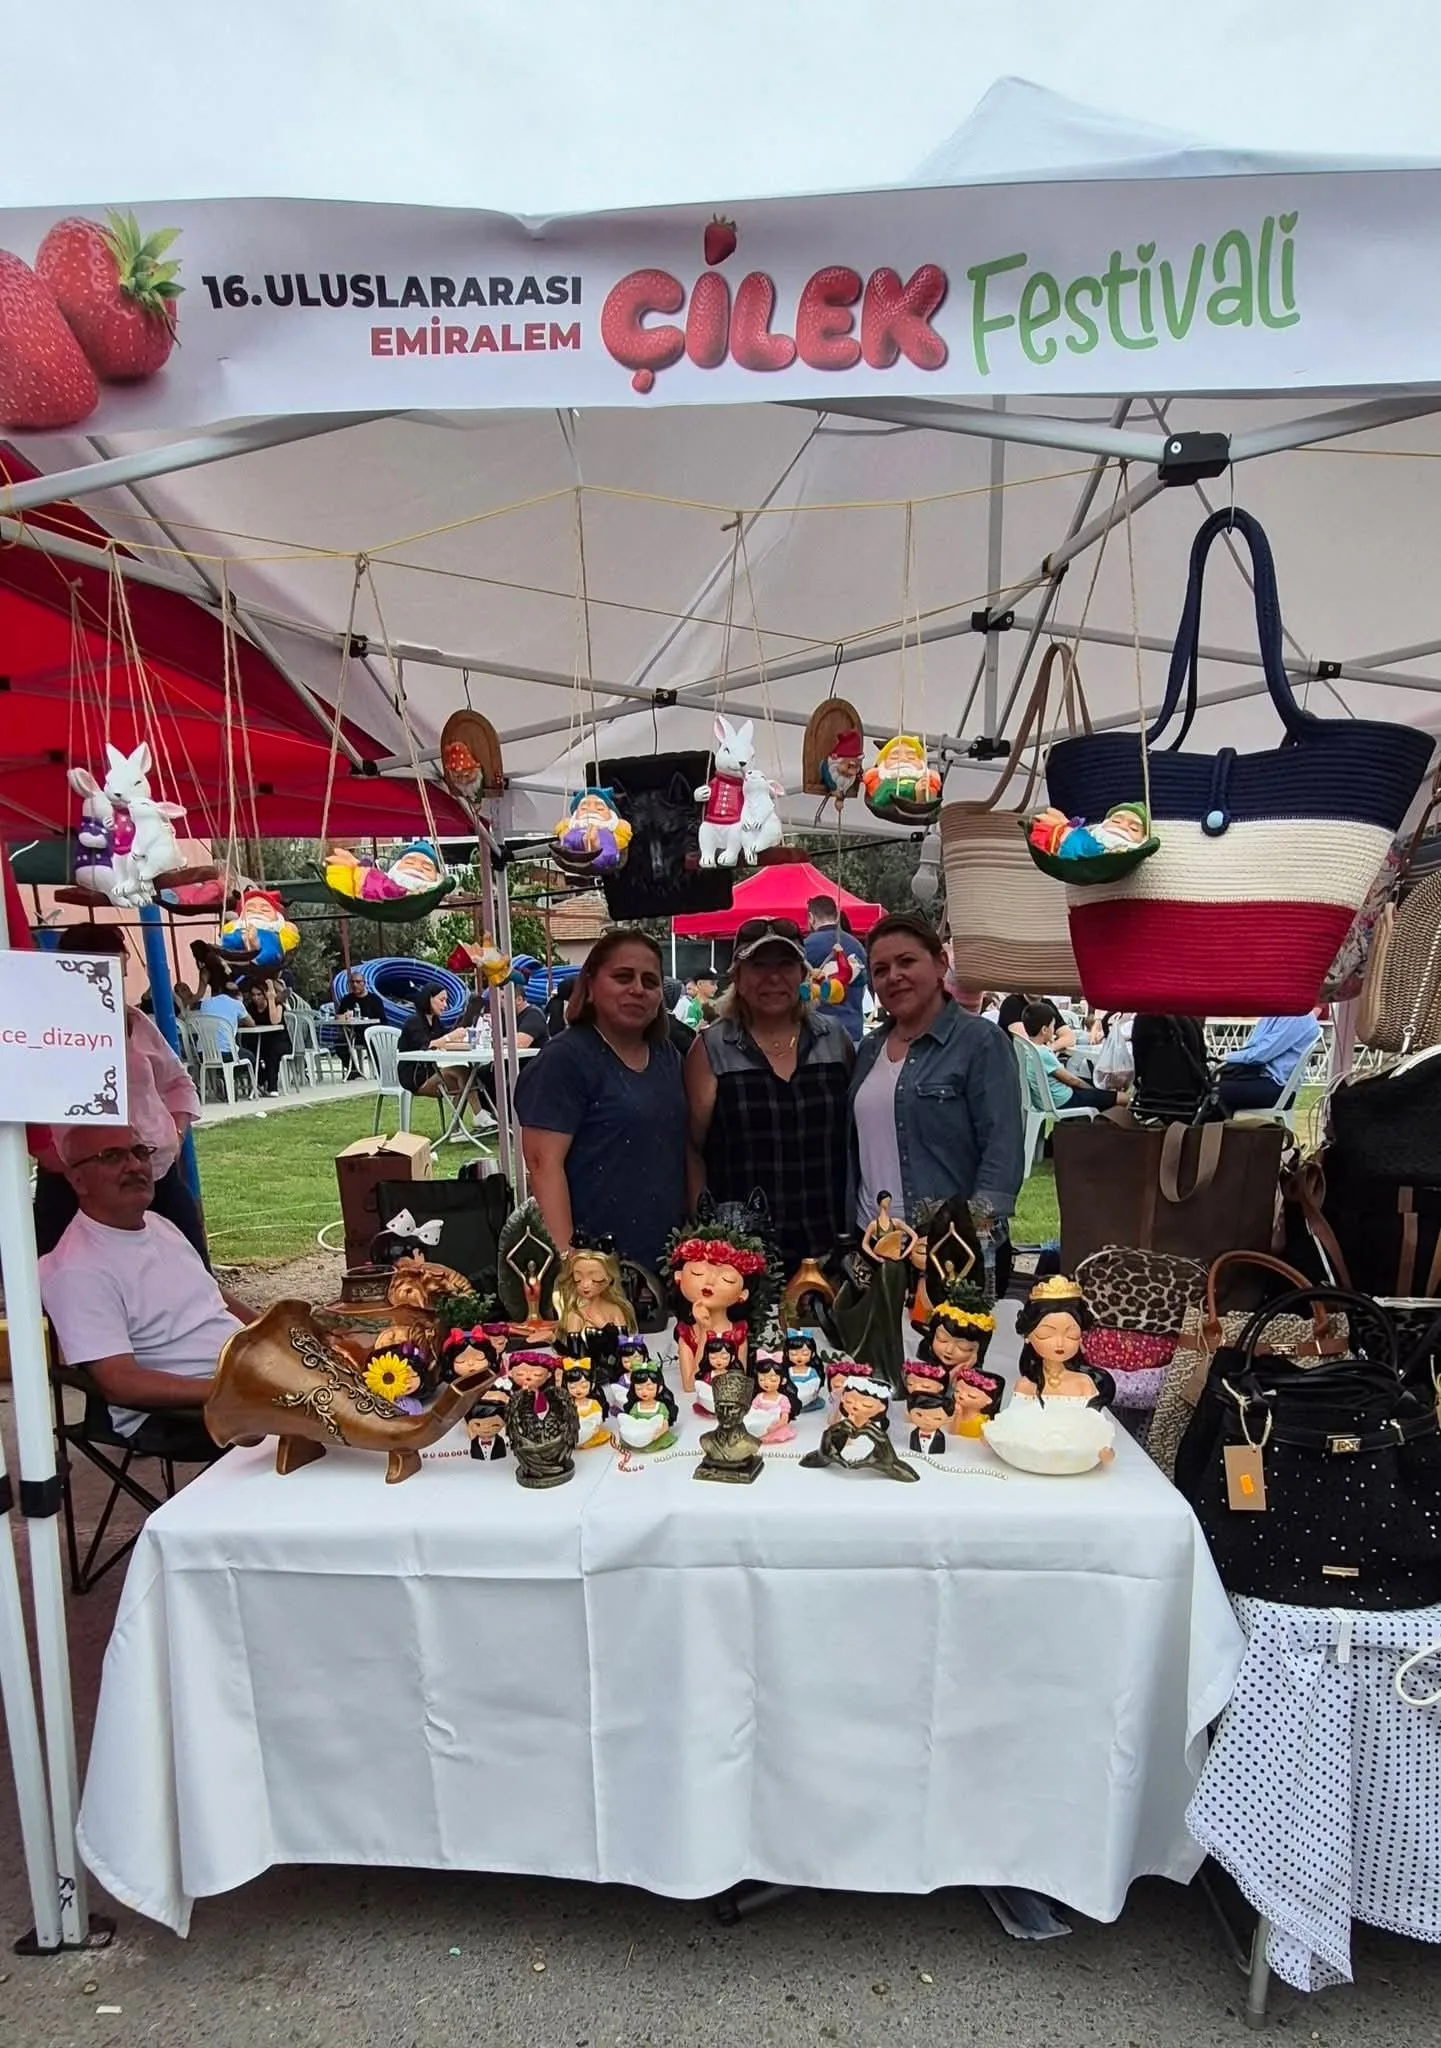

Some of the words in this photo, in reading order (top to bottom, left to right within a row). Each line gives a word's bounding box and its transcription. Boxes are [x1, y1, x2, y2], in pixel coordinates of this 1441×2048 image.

[202, 274, 581, 309] 16.ULUSLARARASI
[601, 214, 950, 393] ÇİLEK
[966, 210, 1301, 375] Festivali
[371, 316, 581, 356] EMİRALEM
